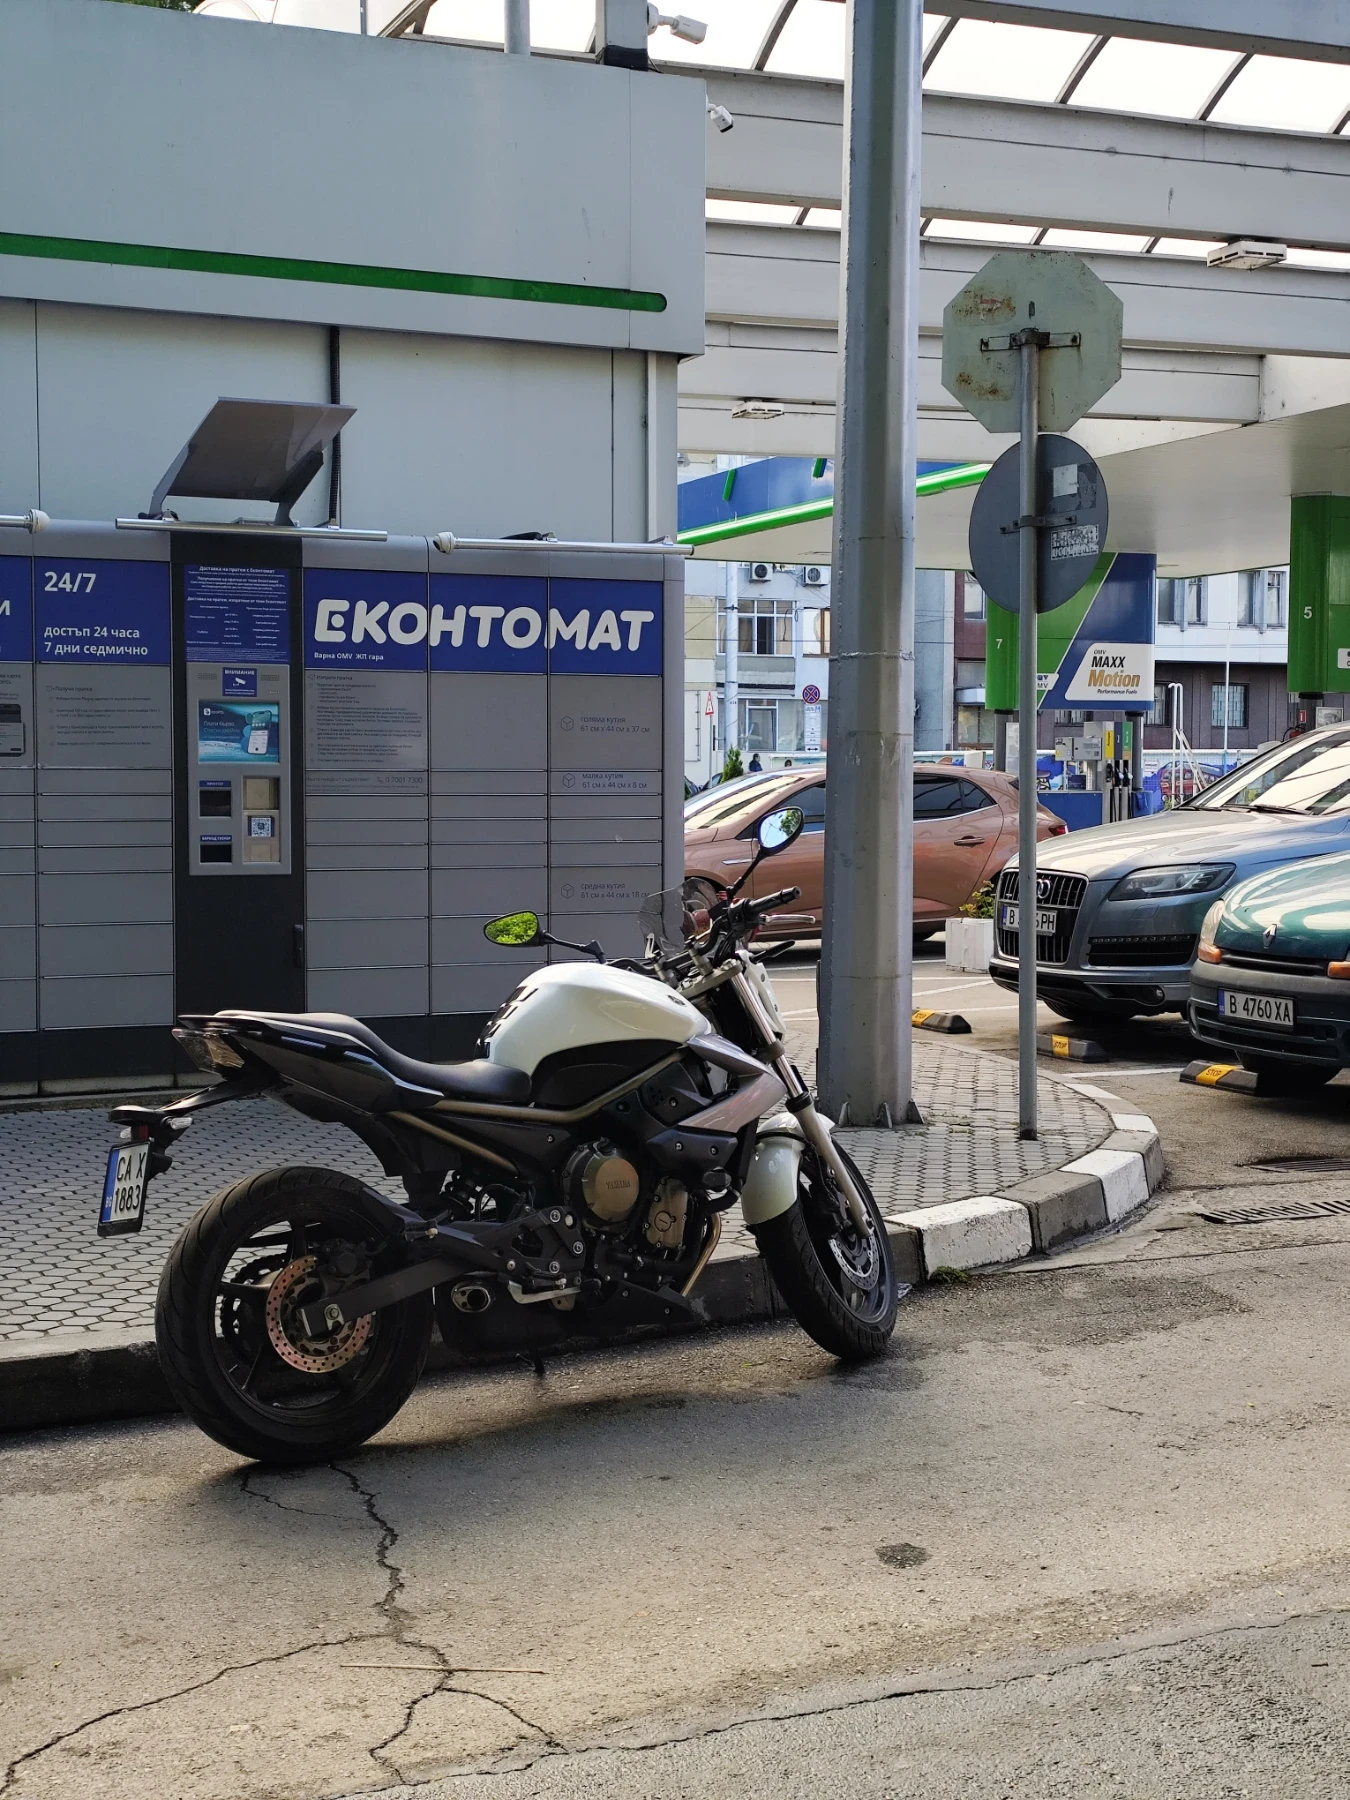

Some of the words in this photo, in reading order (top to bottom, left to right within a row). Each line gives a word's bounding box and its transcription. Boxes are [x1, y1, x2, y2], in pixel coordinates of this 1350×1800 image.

[44, 571, 97, 593] 24/7
[1303, 606, 1313, 619] 5
[313, 598, 655, 652] ЕКОНТОМАТ
[44, 626, 91, 639] достъп
[93, 626, 108, 637] 24
[111, 629, 140, 639] часа
[44, 642, 52, 653] 7
[54, 644, 80, 656] дни
[83, 645, 148, 657] седмично
[996, 638, 1003, 649] 7
[314, 652, 336, 660] Варна
[1091, 656, 1126, 668] MAXX
[1087, 669, 1141, 688] Motion
[580, 716, 605, 724] голяма
[606, 717, 626, 725] кутия
[604, 773, 624, 781] кутия
[580, 883, 605, 891] средна
[606, 883, 626, 891] кутия
[1009, 909, 1015, 925] B
[1040, 913, 1055, 931] PH
[1229, 994, 1237, 1014] B
[1242, 997, 1272, 1019] 4760
[1274, 1000, 1291, 1023] XA
[1206, 1068, 1222, 1077] STOP
[116, 1154, 132, 1182] CA
[136, 1152, 146, 1179] X
[114, 1184, 141, 1214] 1883
